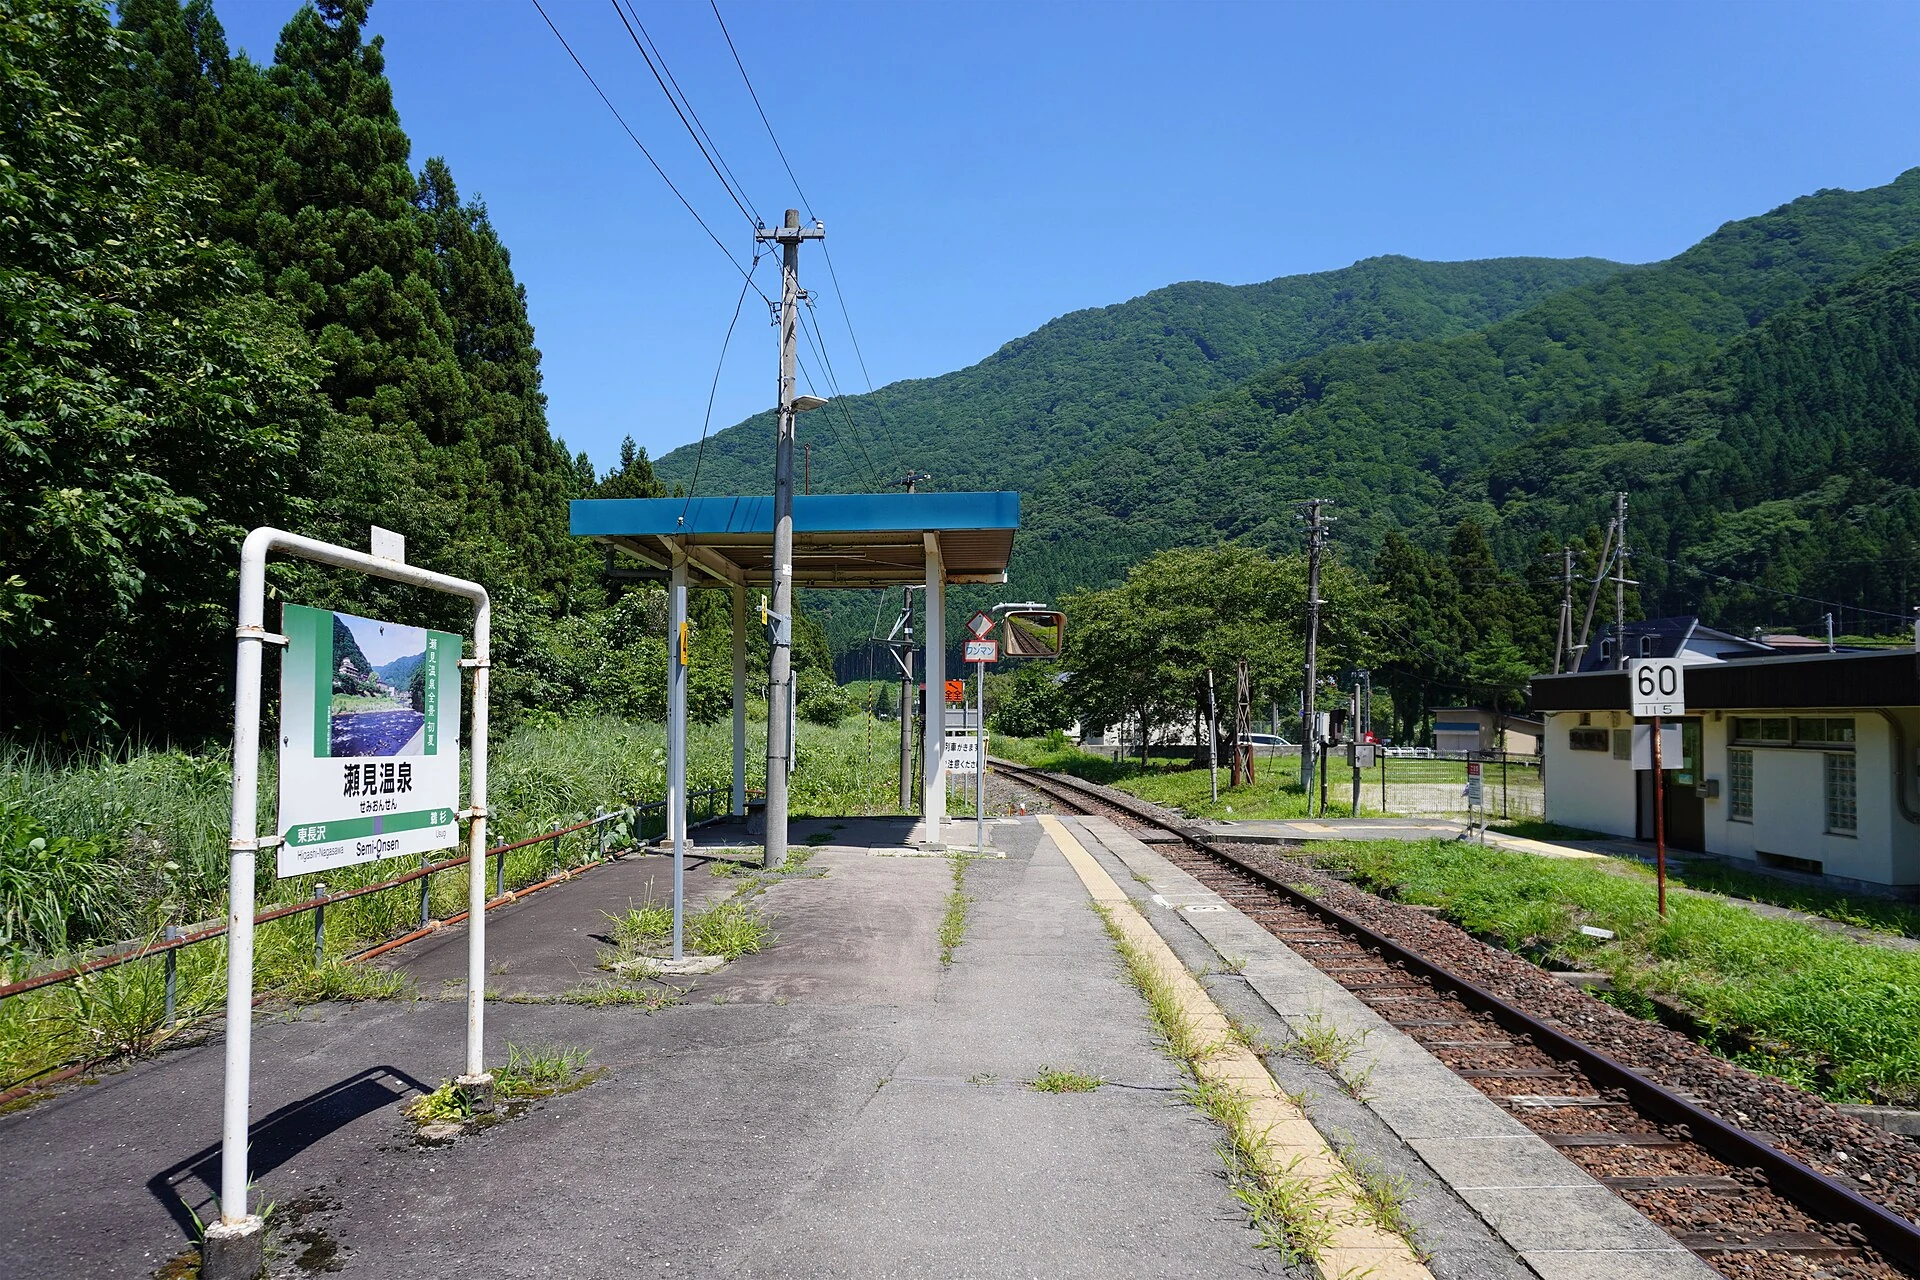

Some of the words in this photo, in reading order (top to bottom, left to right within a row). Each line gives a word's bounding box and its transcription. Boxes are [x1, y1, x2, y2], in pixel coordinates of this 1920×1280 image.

[966, 646, 994, 656] ワンマン
[1638, 665, 1678, 696] 60
[1645, 704, 1673, 715] 115
[343, 762, 413, 798] 瀬見温泉
[359, 798, 398, 813] せみおんせん
[297, 825, 326, 843] 東長沢
[356, 838, 400, 857] Semi-Onsen
